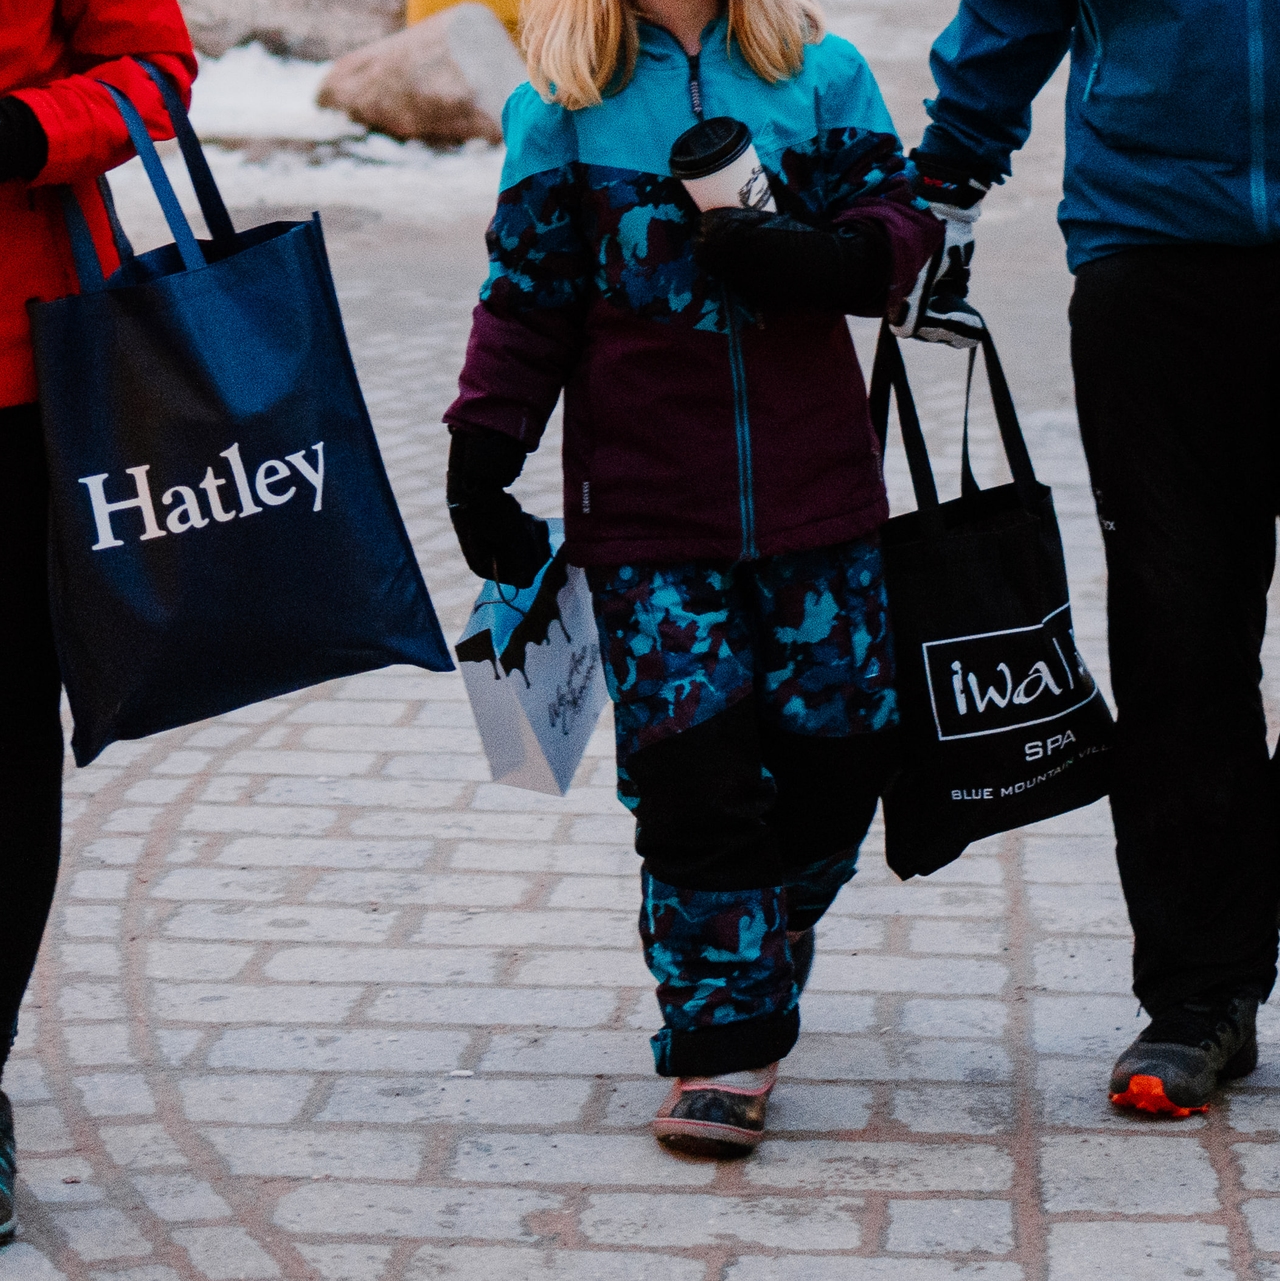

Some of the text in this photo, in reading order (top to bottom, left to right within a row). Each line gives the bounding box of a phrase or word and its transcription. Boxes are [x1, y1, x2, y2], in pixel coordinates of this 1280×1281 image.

[78, 441, 324, 551] Hatley
[1025, 730, 1077, 762] SPA
[951, 788, 993, 801] BLUE
[1001, 757, 1074, 798] MOUNTAIN
